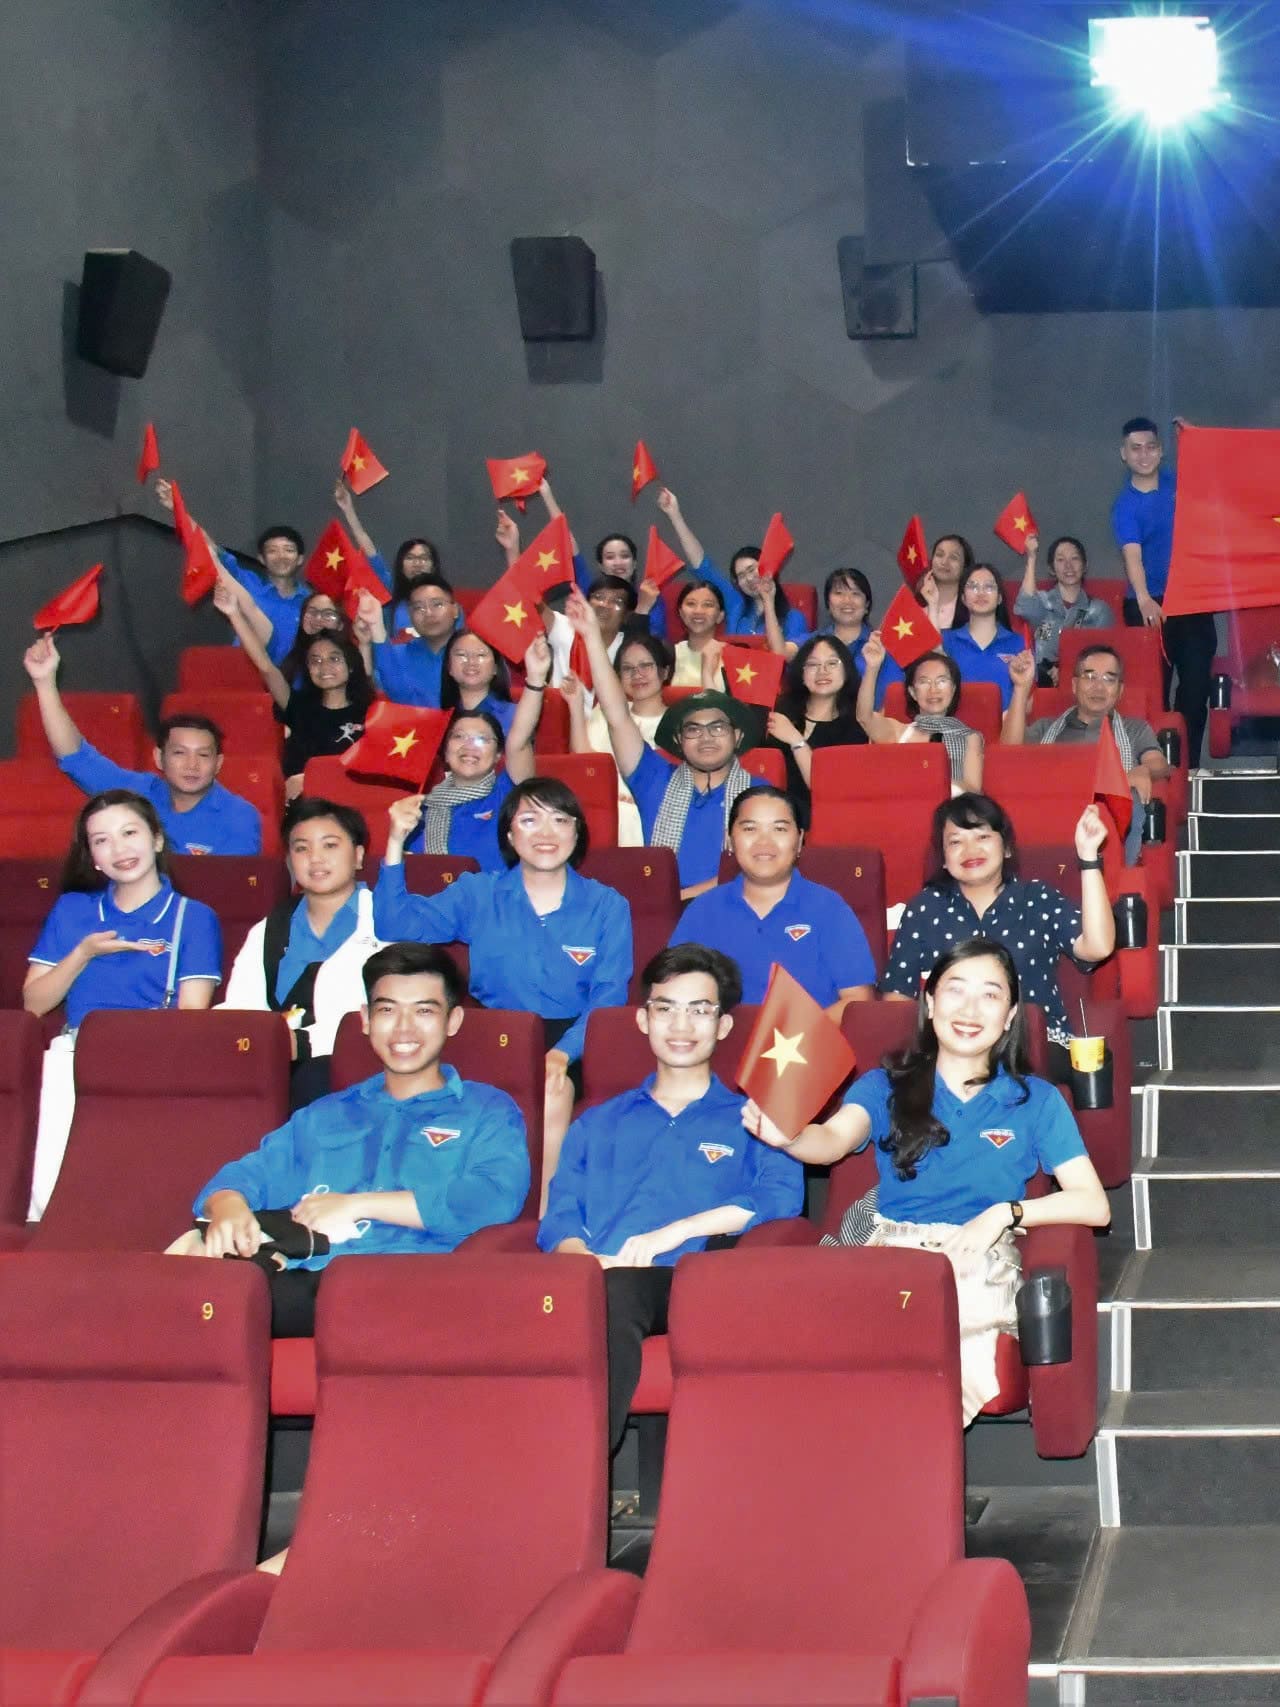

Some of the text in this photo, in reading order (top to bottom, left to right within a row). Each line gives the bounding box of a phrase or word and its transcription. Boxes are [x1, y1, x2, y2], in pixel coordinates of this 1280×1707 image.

[643, 866, 652, 877] 9
[854, 866, 863, 877] 8
[1057, 864, 1066, 875] 7
[441, 872, 453, 884] 10
[236, 1037, 250, 1051] 10
[499, 1033, 509, 1047] 9
[542, 1295, 554, 1314] 8
[899, 1290, 912, 1309] 7
[202, 1302, 214, 1320] 9
